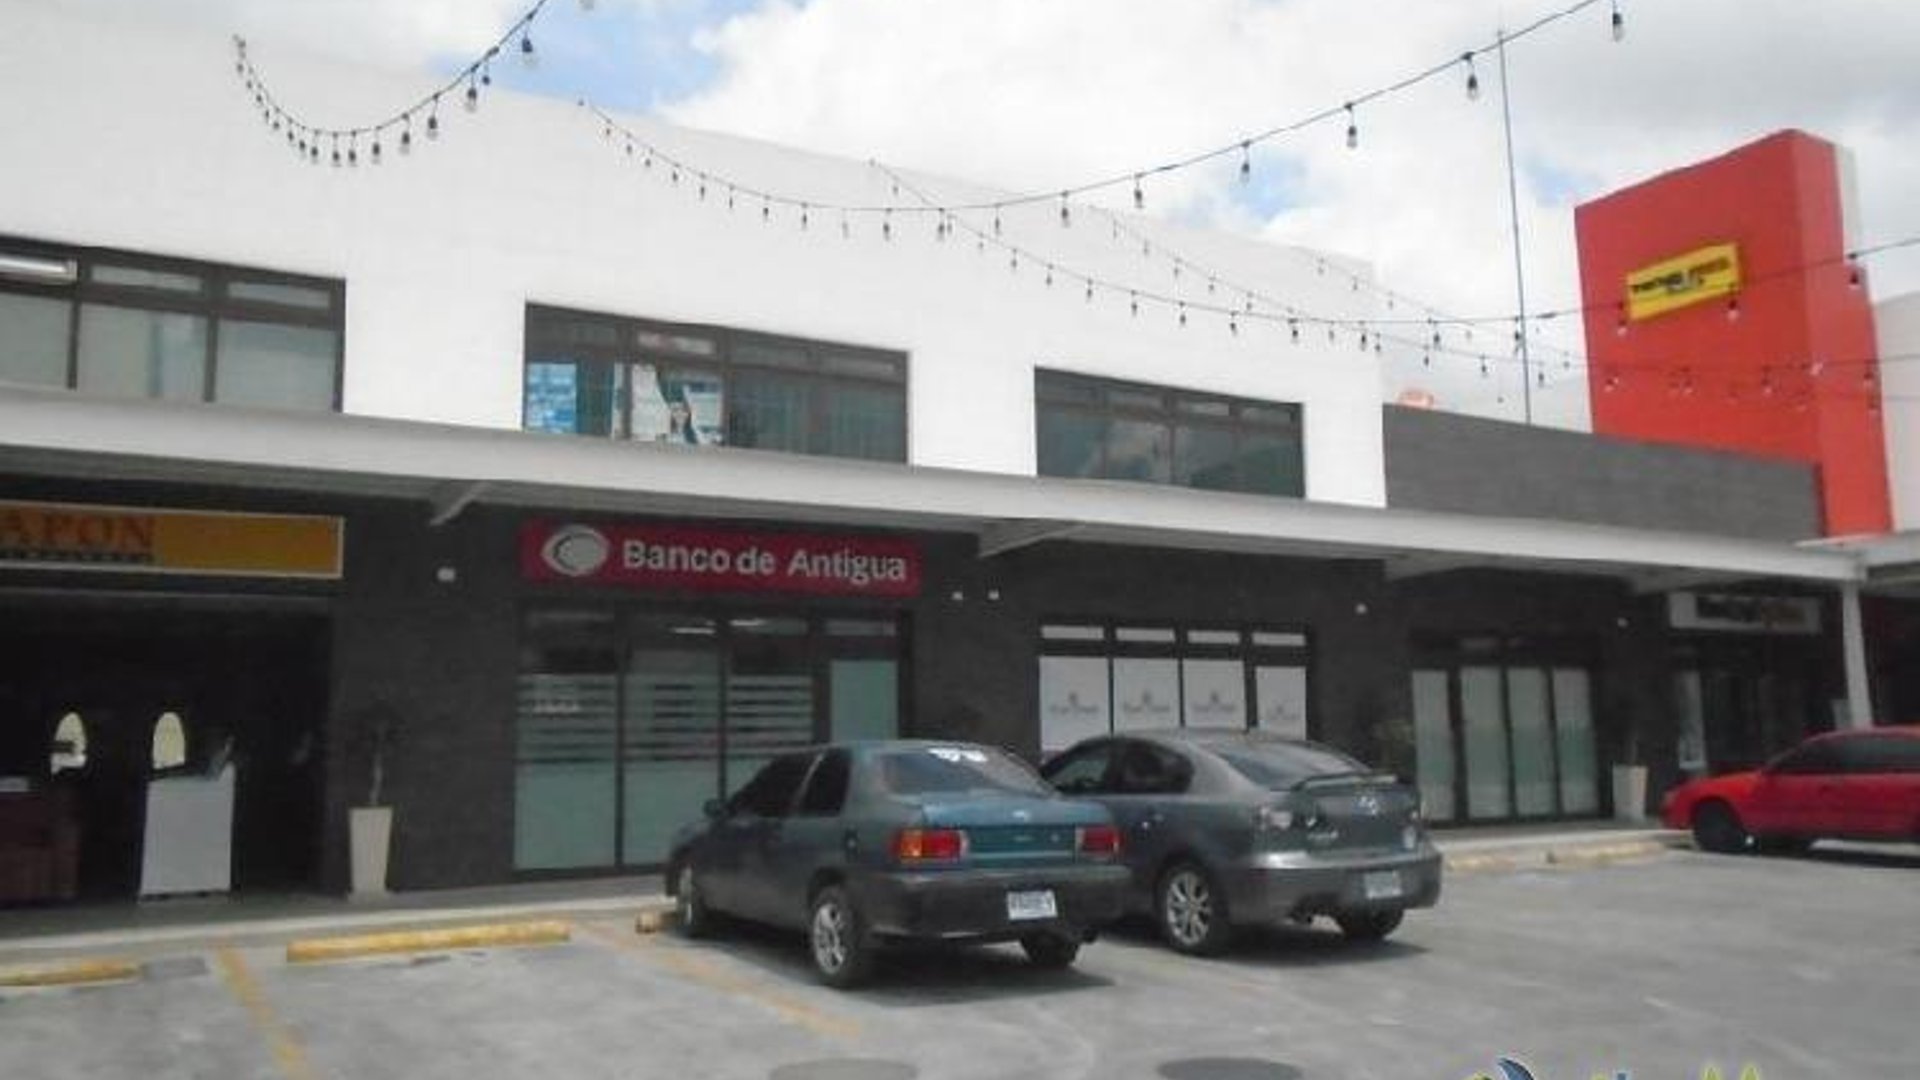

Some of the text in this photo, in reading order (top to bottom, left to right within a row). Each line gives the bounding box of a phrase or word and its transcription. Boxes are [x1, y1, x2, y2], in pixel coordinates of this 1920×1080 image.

[622, 539, 907, 584] Banco de Antigua
